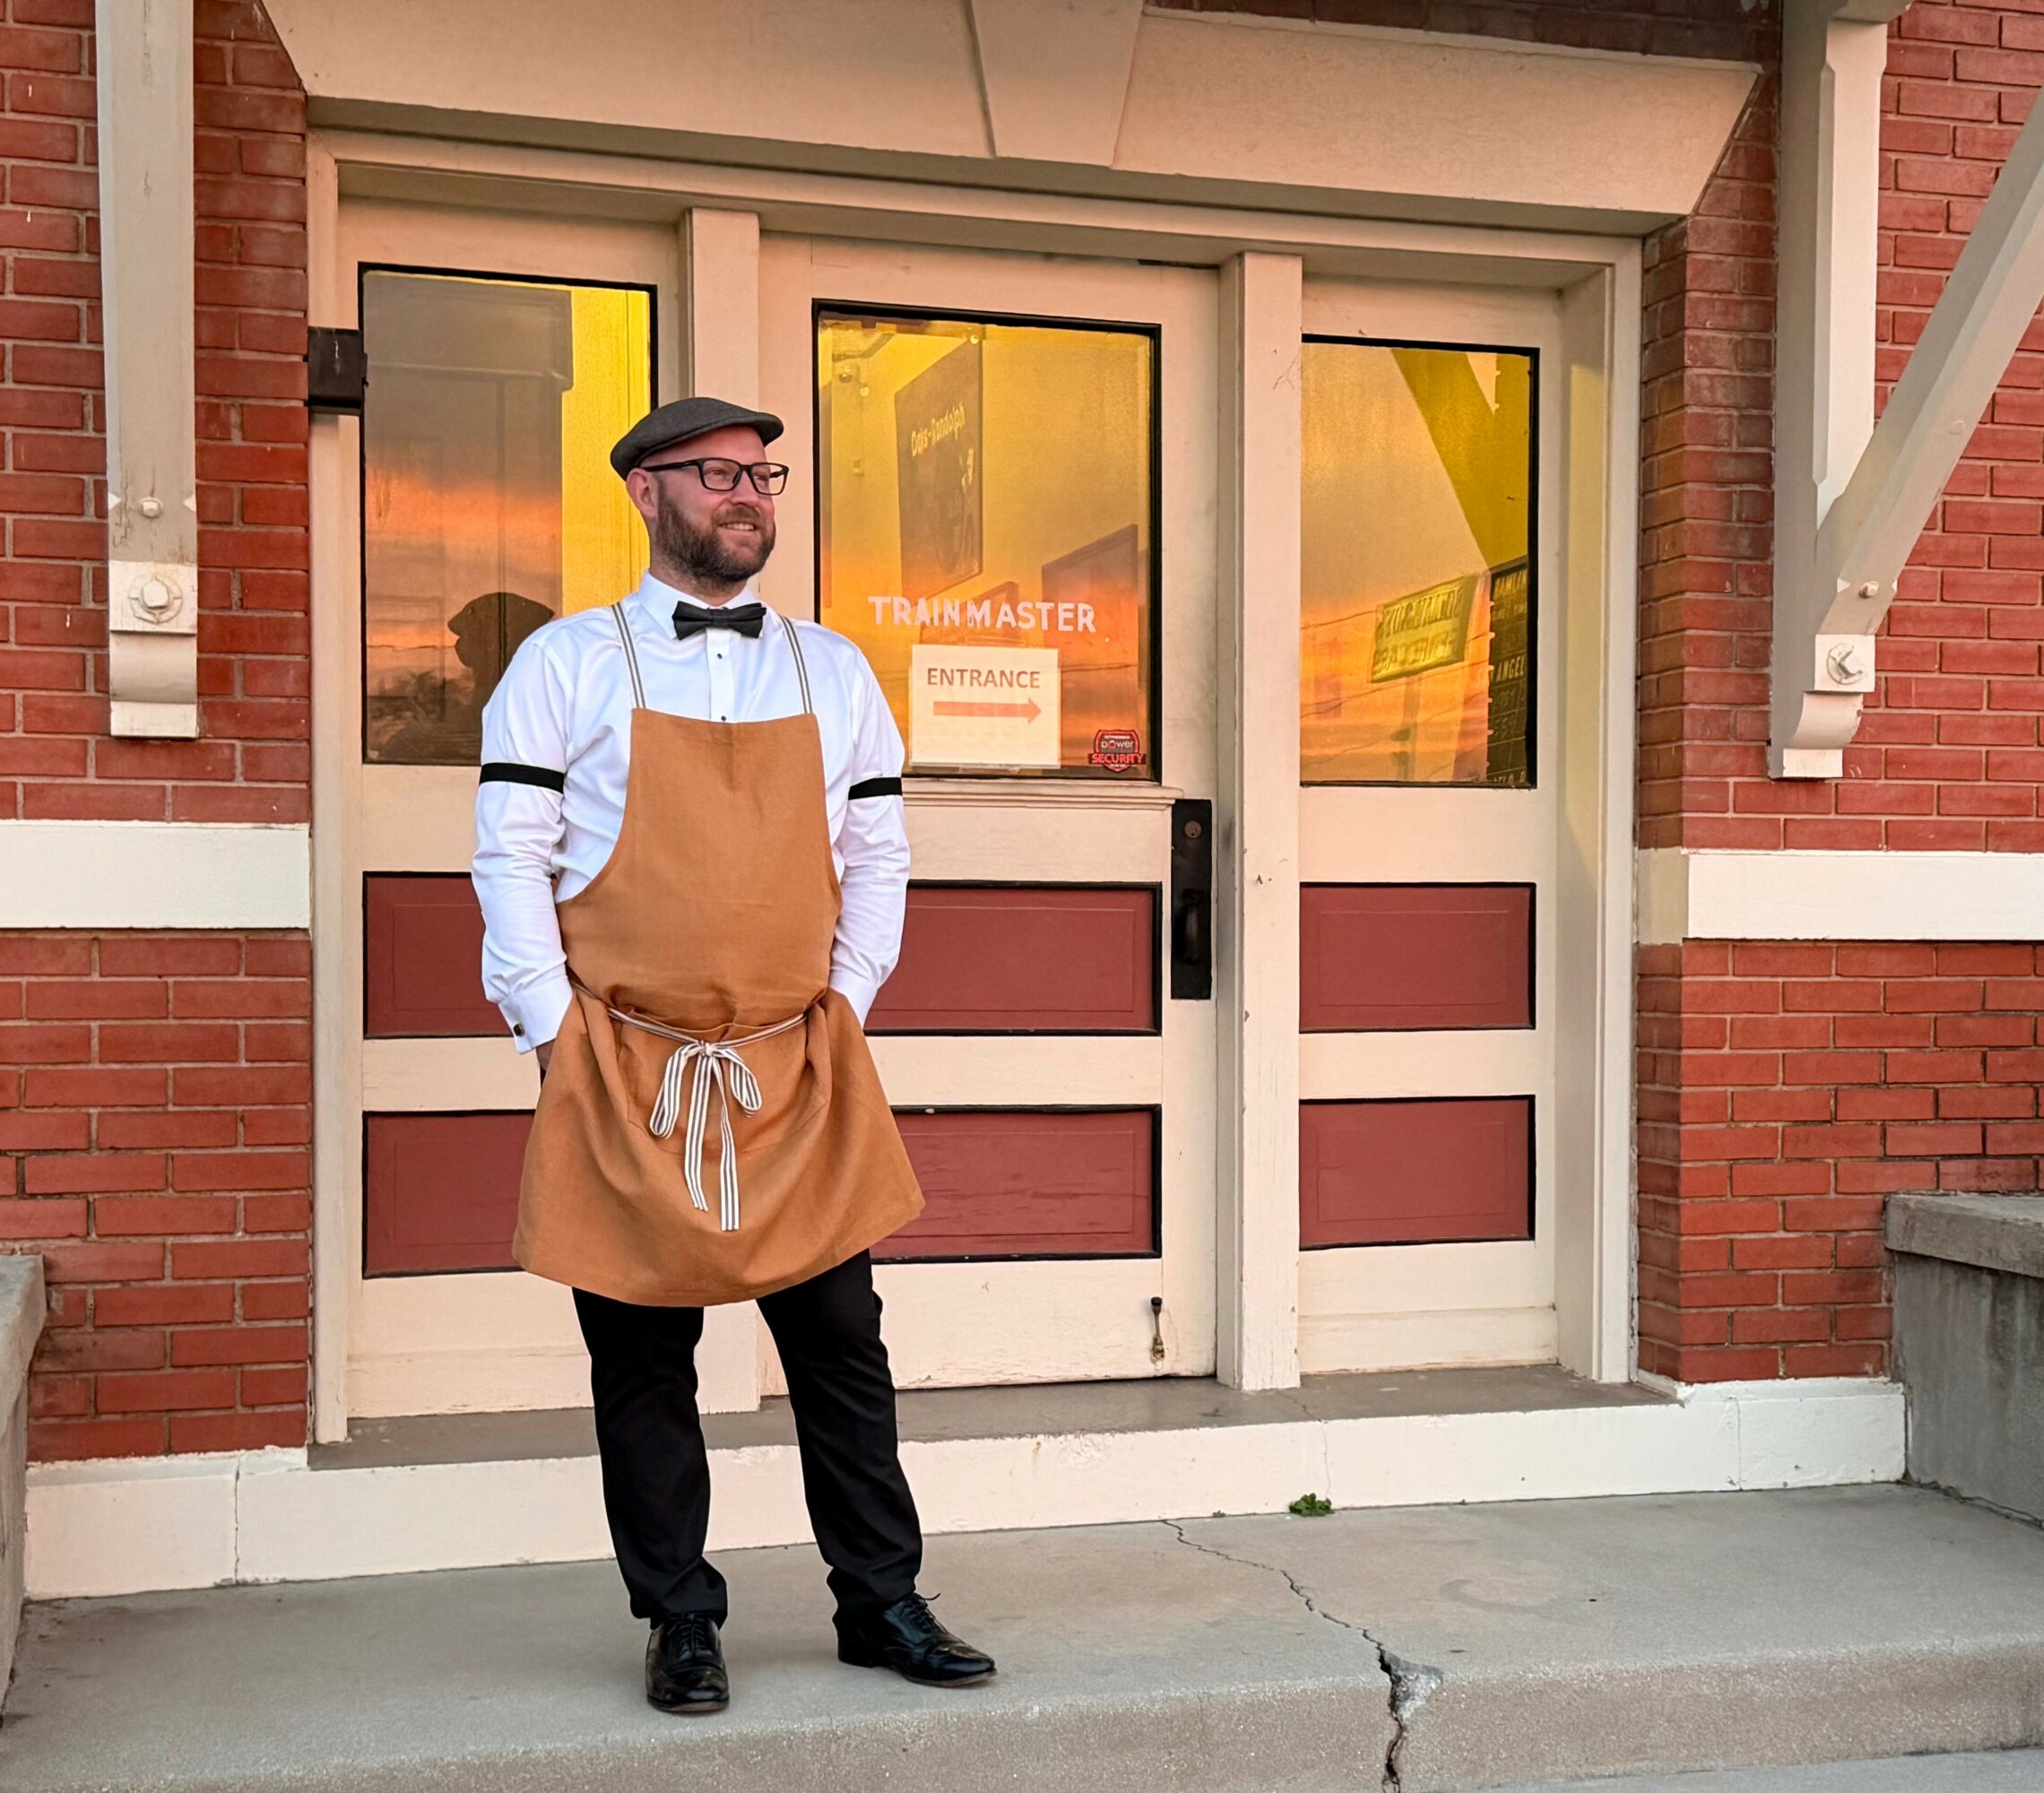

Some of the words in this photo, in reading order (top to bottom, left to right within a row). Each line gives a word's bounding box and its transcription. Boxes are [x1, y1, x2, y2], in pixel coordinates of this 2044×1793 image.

[868, 595, 1096, 633] TRAINMASTER
[927, 668, 1040, 689] ENTRANCE
[1101, 740, 1134, 749] power
[1092, 753, 1143, 763] SECURITY
